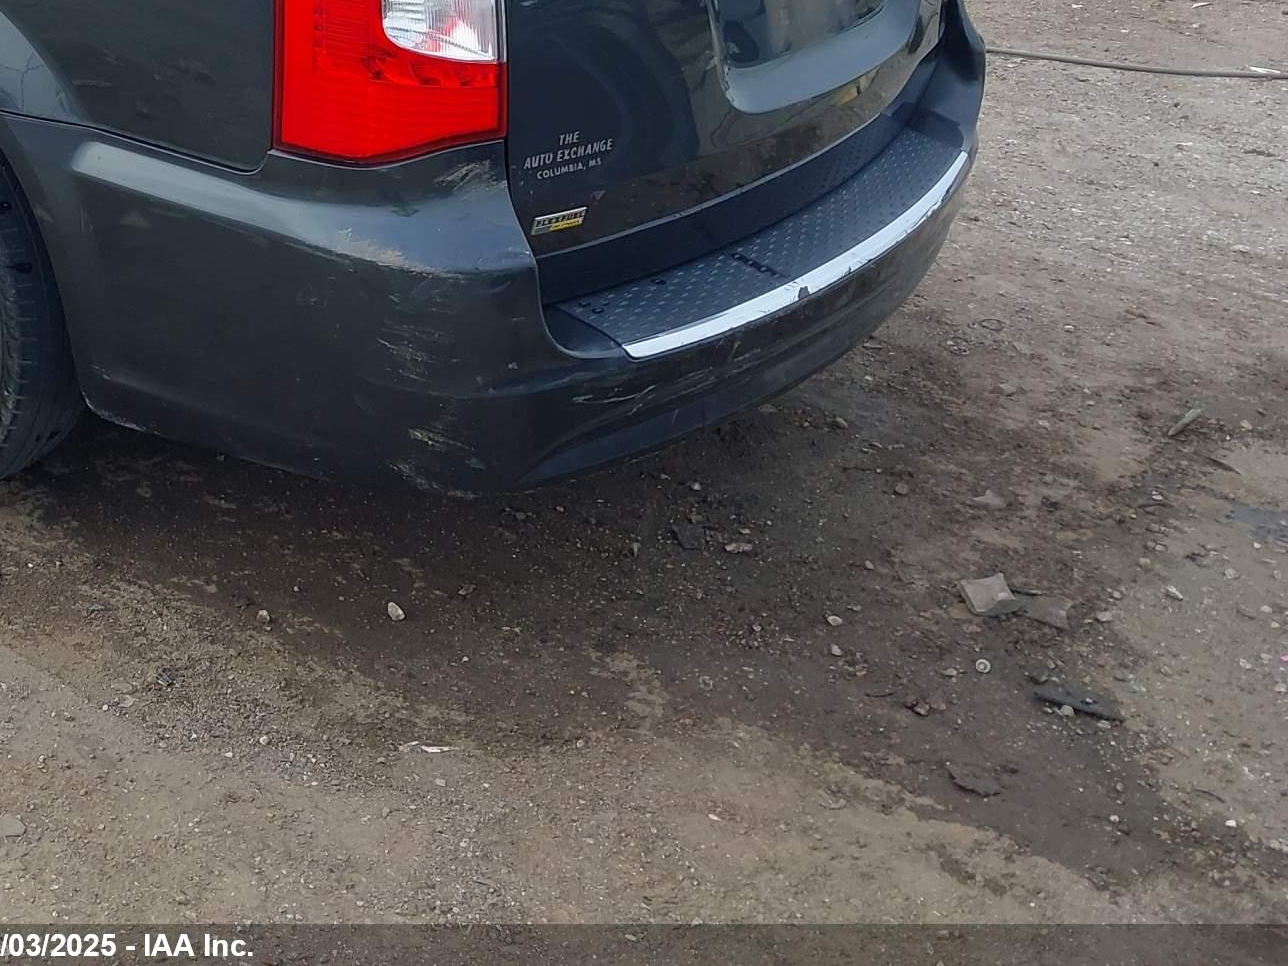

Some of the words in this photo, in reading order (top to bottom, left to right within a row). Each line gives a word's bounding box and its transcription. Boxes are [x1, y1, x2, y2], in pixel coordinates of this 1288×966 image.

[559, 130, 580, 146] THE
[523, 152, 554, 170] AUTO
[556, 138, 613, 162] EXCHANGE
[536, 161, 586, 179] COLUMBIA,
[588, 157, 602, 168] MS
